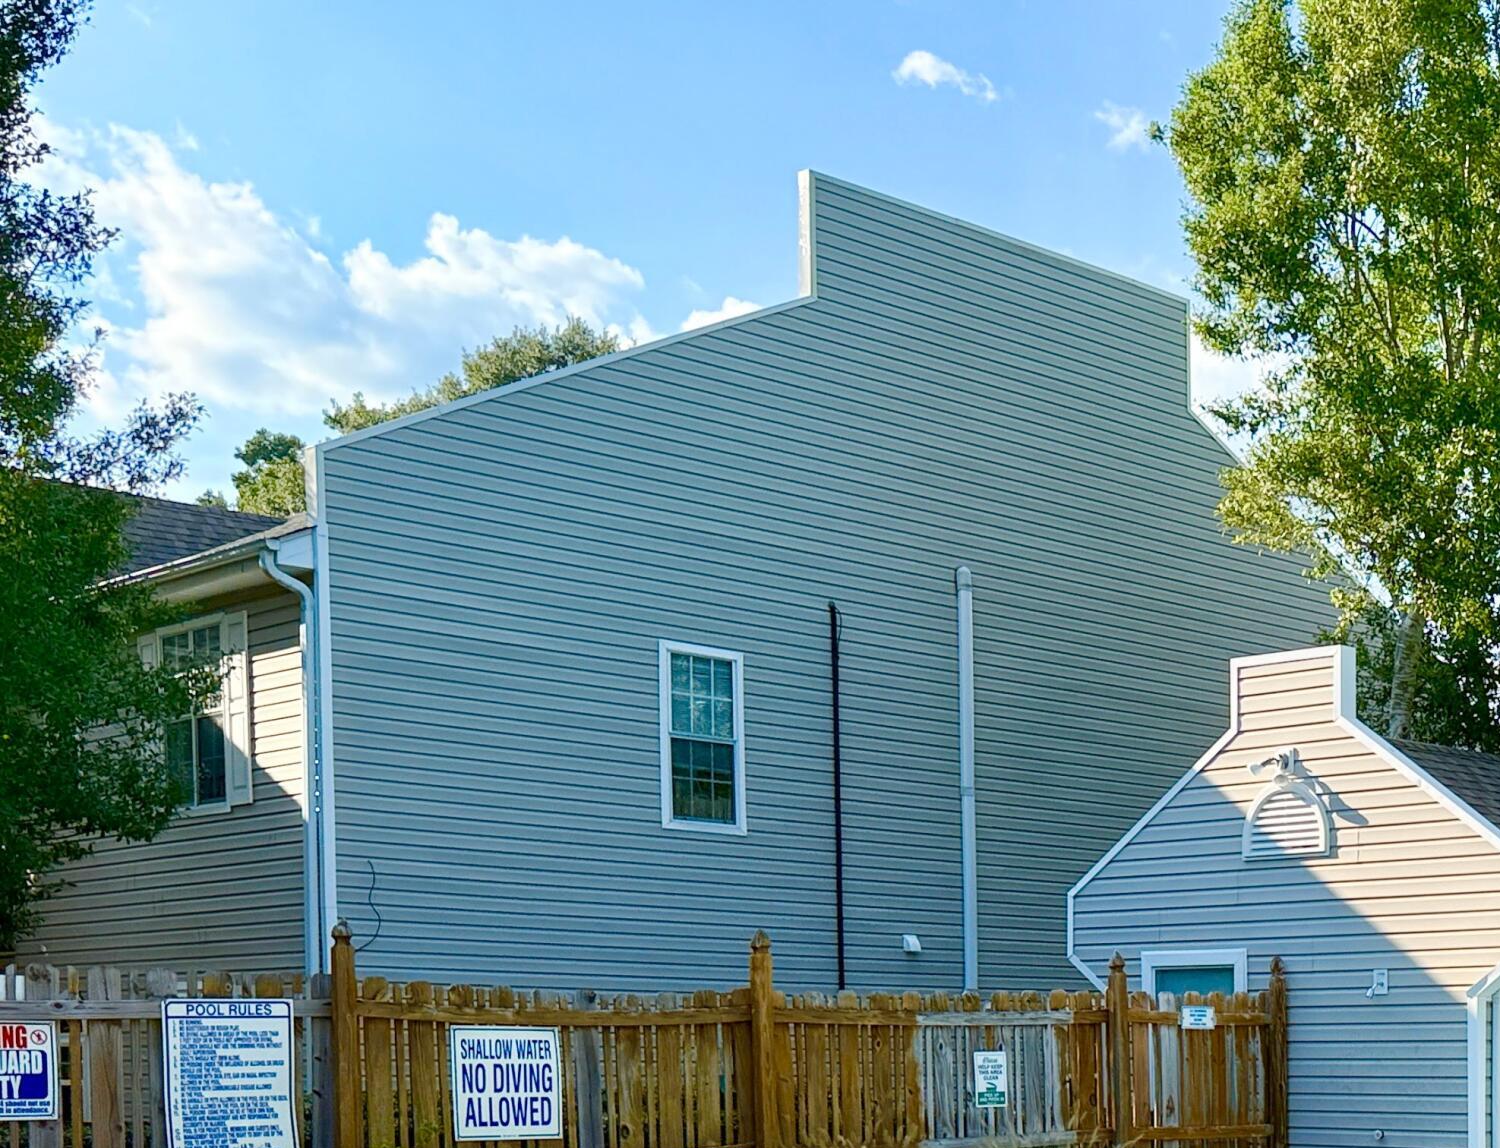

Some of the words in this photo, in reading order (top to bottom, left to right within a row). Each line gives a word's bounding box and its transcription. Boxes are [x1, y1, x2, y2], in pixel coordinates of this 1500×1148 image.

[186, 1004, 224, 1016] POOL
[229, 1004, 272, 1016] RULES
[0, 1026, 27, 1048] NG
[461, 1039, 512, 1060] SHALLOW
[515, 1039, 551, 1059] WATER
[0, 1075, 21, 1099] TY
[462, 1063, 486, 1093] NO
[493, 1063, 553, 1093] DIVING
[465, 1096, 552, 1127] ALLOWED
